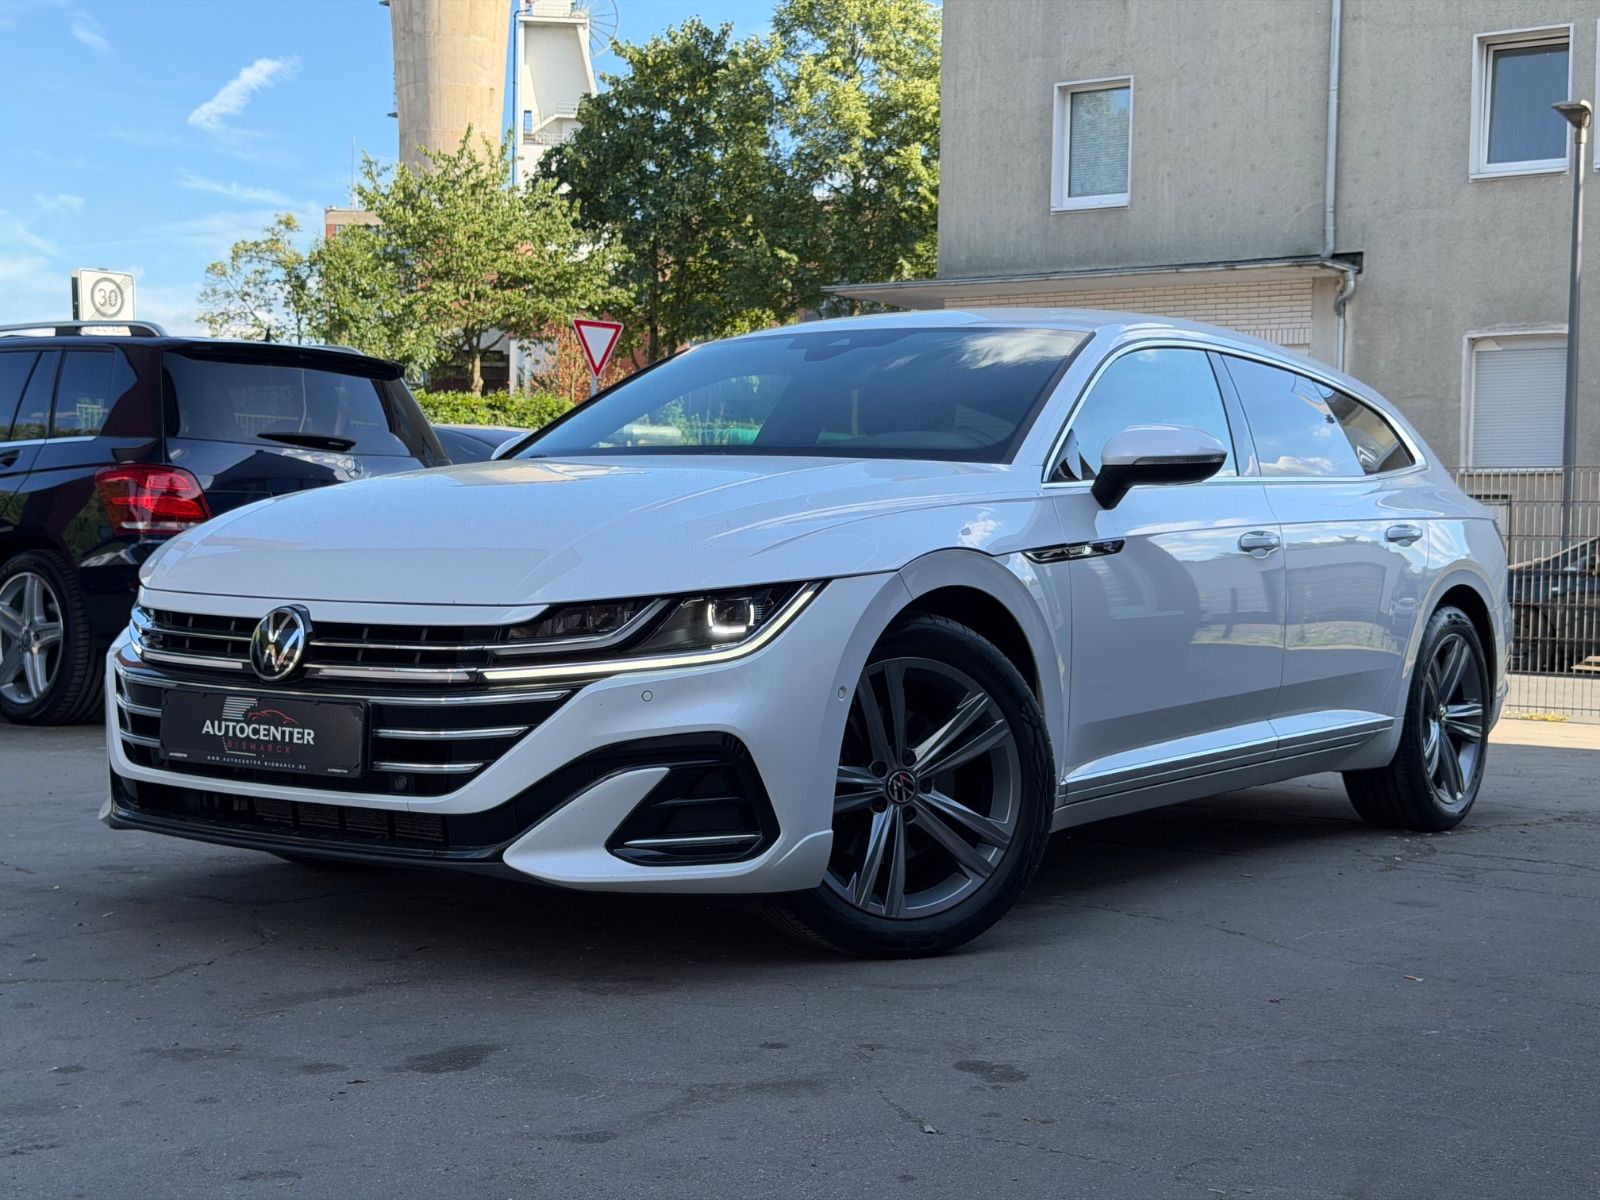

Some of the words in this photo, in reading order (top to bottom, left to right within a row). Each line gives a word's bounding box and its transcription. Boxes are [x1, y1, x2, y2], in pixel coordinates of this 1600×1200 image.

[98, 288, 118, 307] 30
[201, 719, 315, 745] AUTOCENTER
[227, 739, 291, 753] BISMARCK
